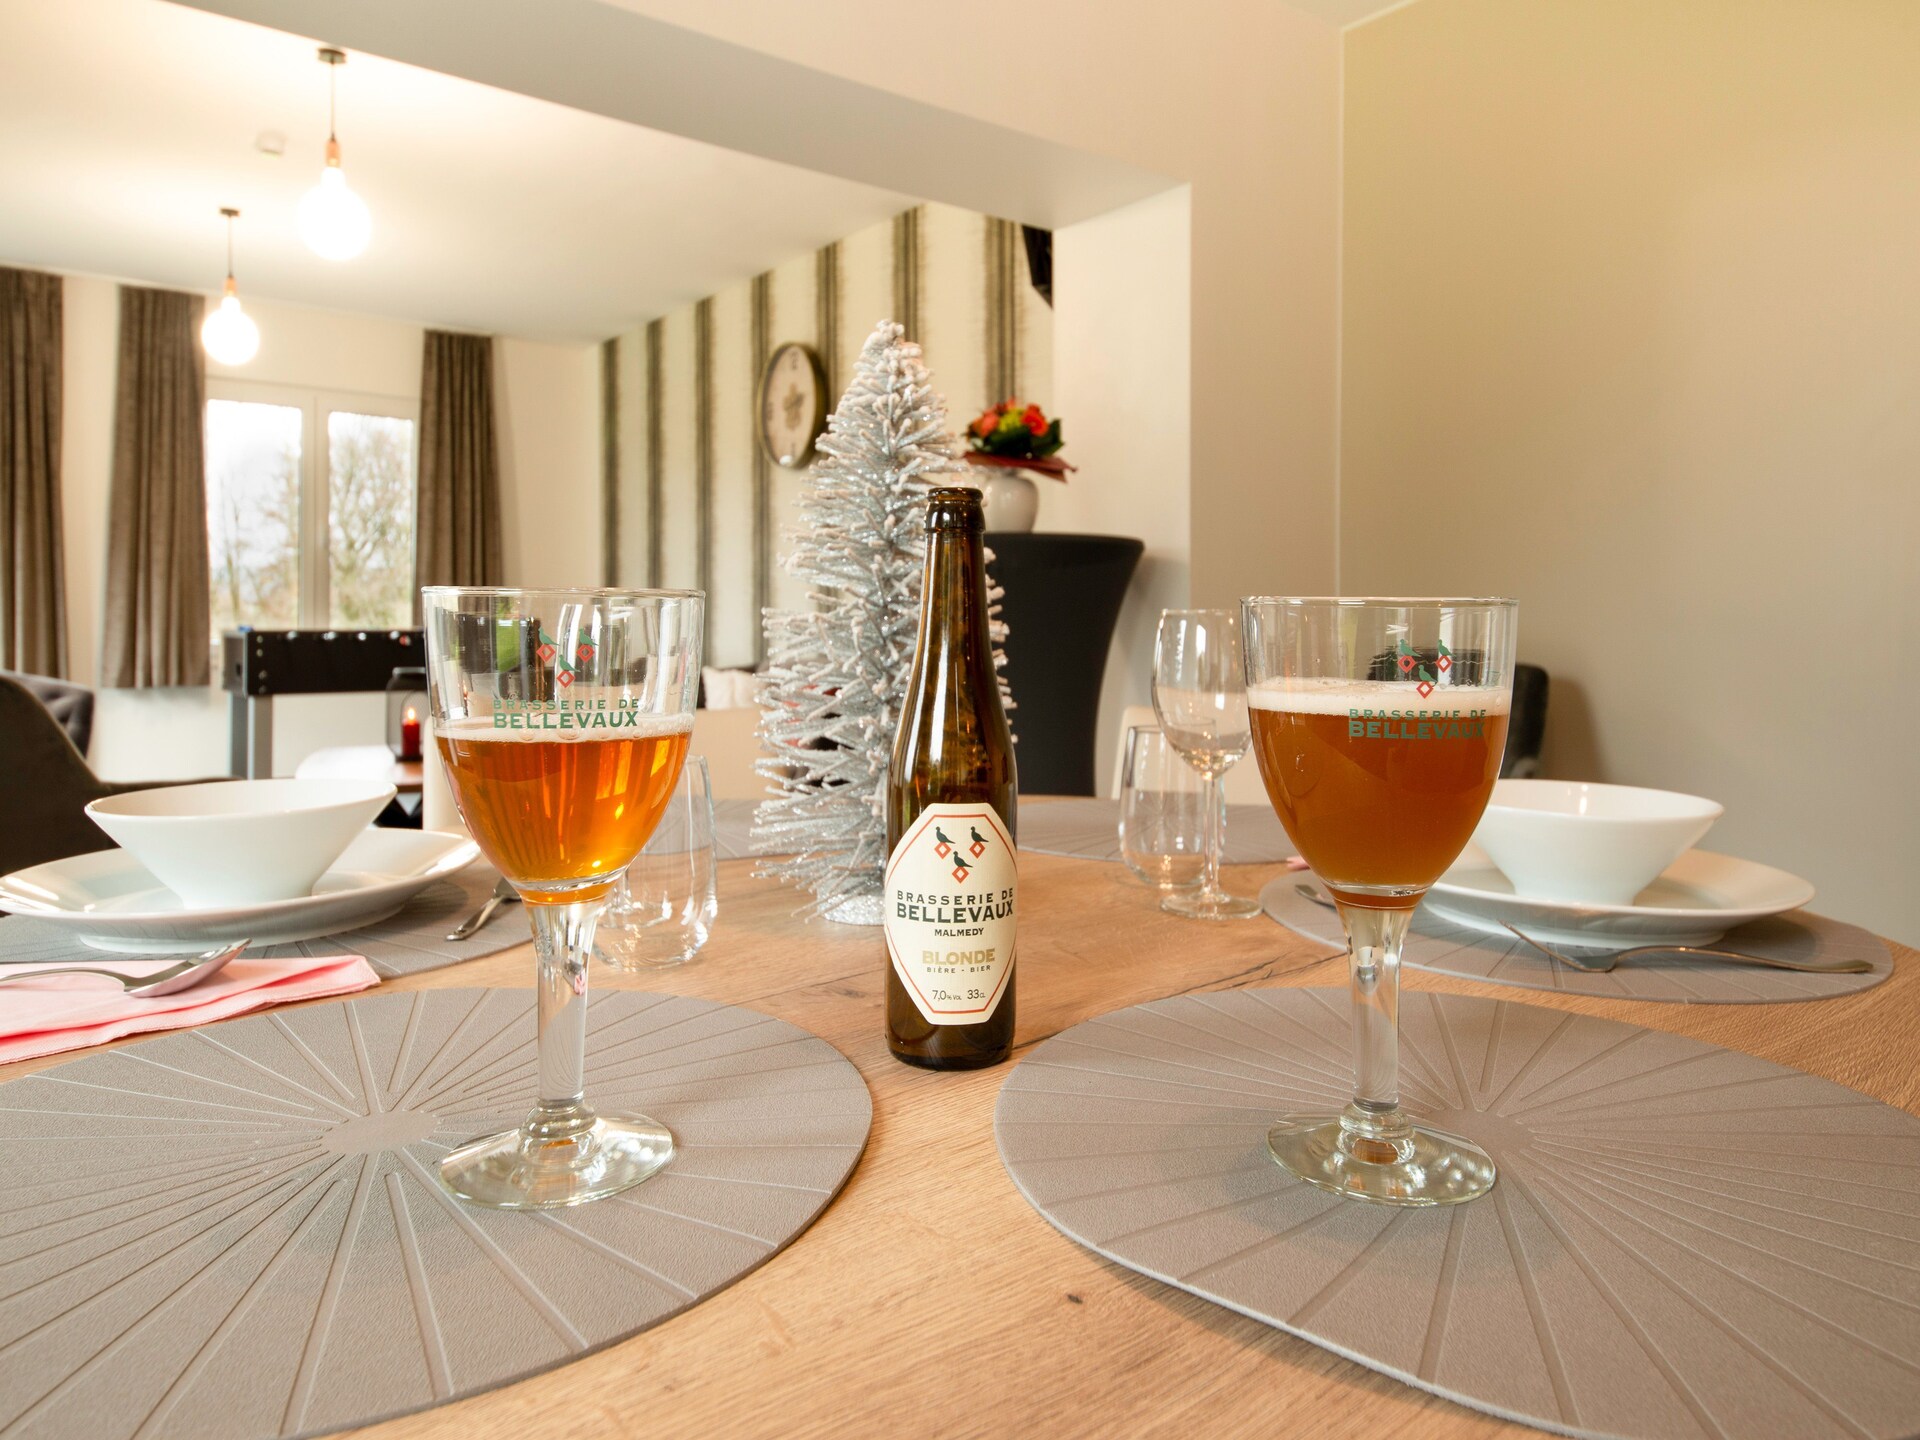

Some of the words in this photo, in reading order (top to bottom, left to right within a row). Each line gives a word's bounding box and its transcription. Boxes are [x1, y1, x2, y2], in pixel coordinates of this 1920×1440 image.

[493, 699, 606, 711] BRASSERIE
[618, 698, 639, 709] DE
[493, 711, 639, 729] BELLEVAUX
[1349, 708, 1461, 721] BRASSERIE
[1469, 709, 1487, 719] DE
[1348, 720, 1486, 740] BELLEVAUX
[897, 890, 994, 906] BRASSERIE
[1001, 887, 1014, 901] DE
[897, 900, 1014, 924] BELLEVAUX
[934, 927, 985, 937] MALMEDY
[922, 948, 996, 966] BLONDE
[926, 966, 956, 974] BIÈRE
[970, 964, 991, 973] BIER
